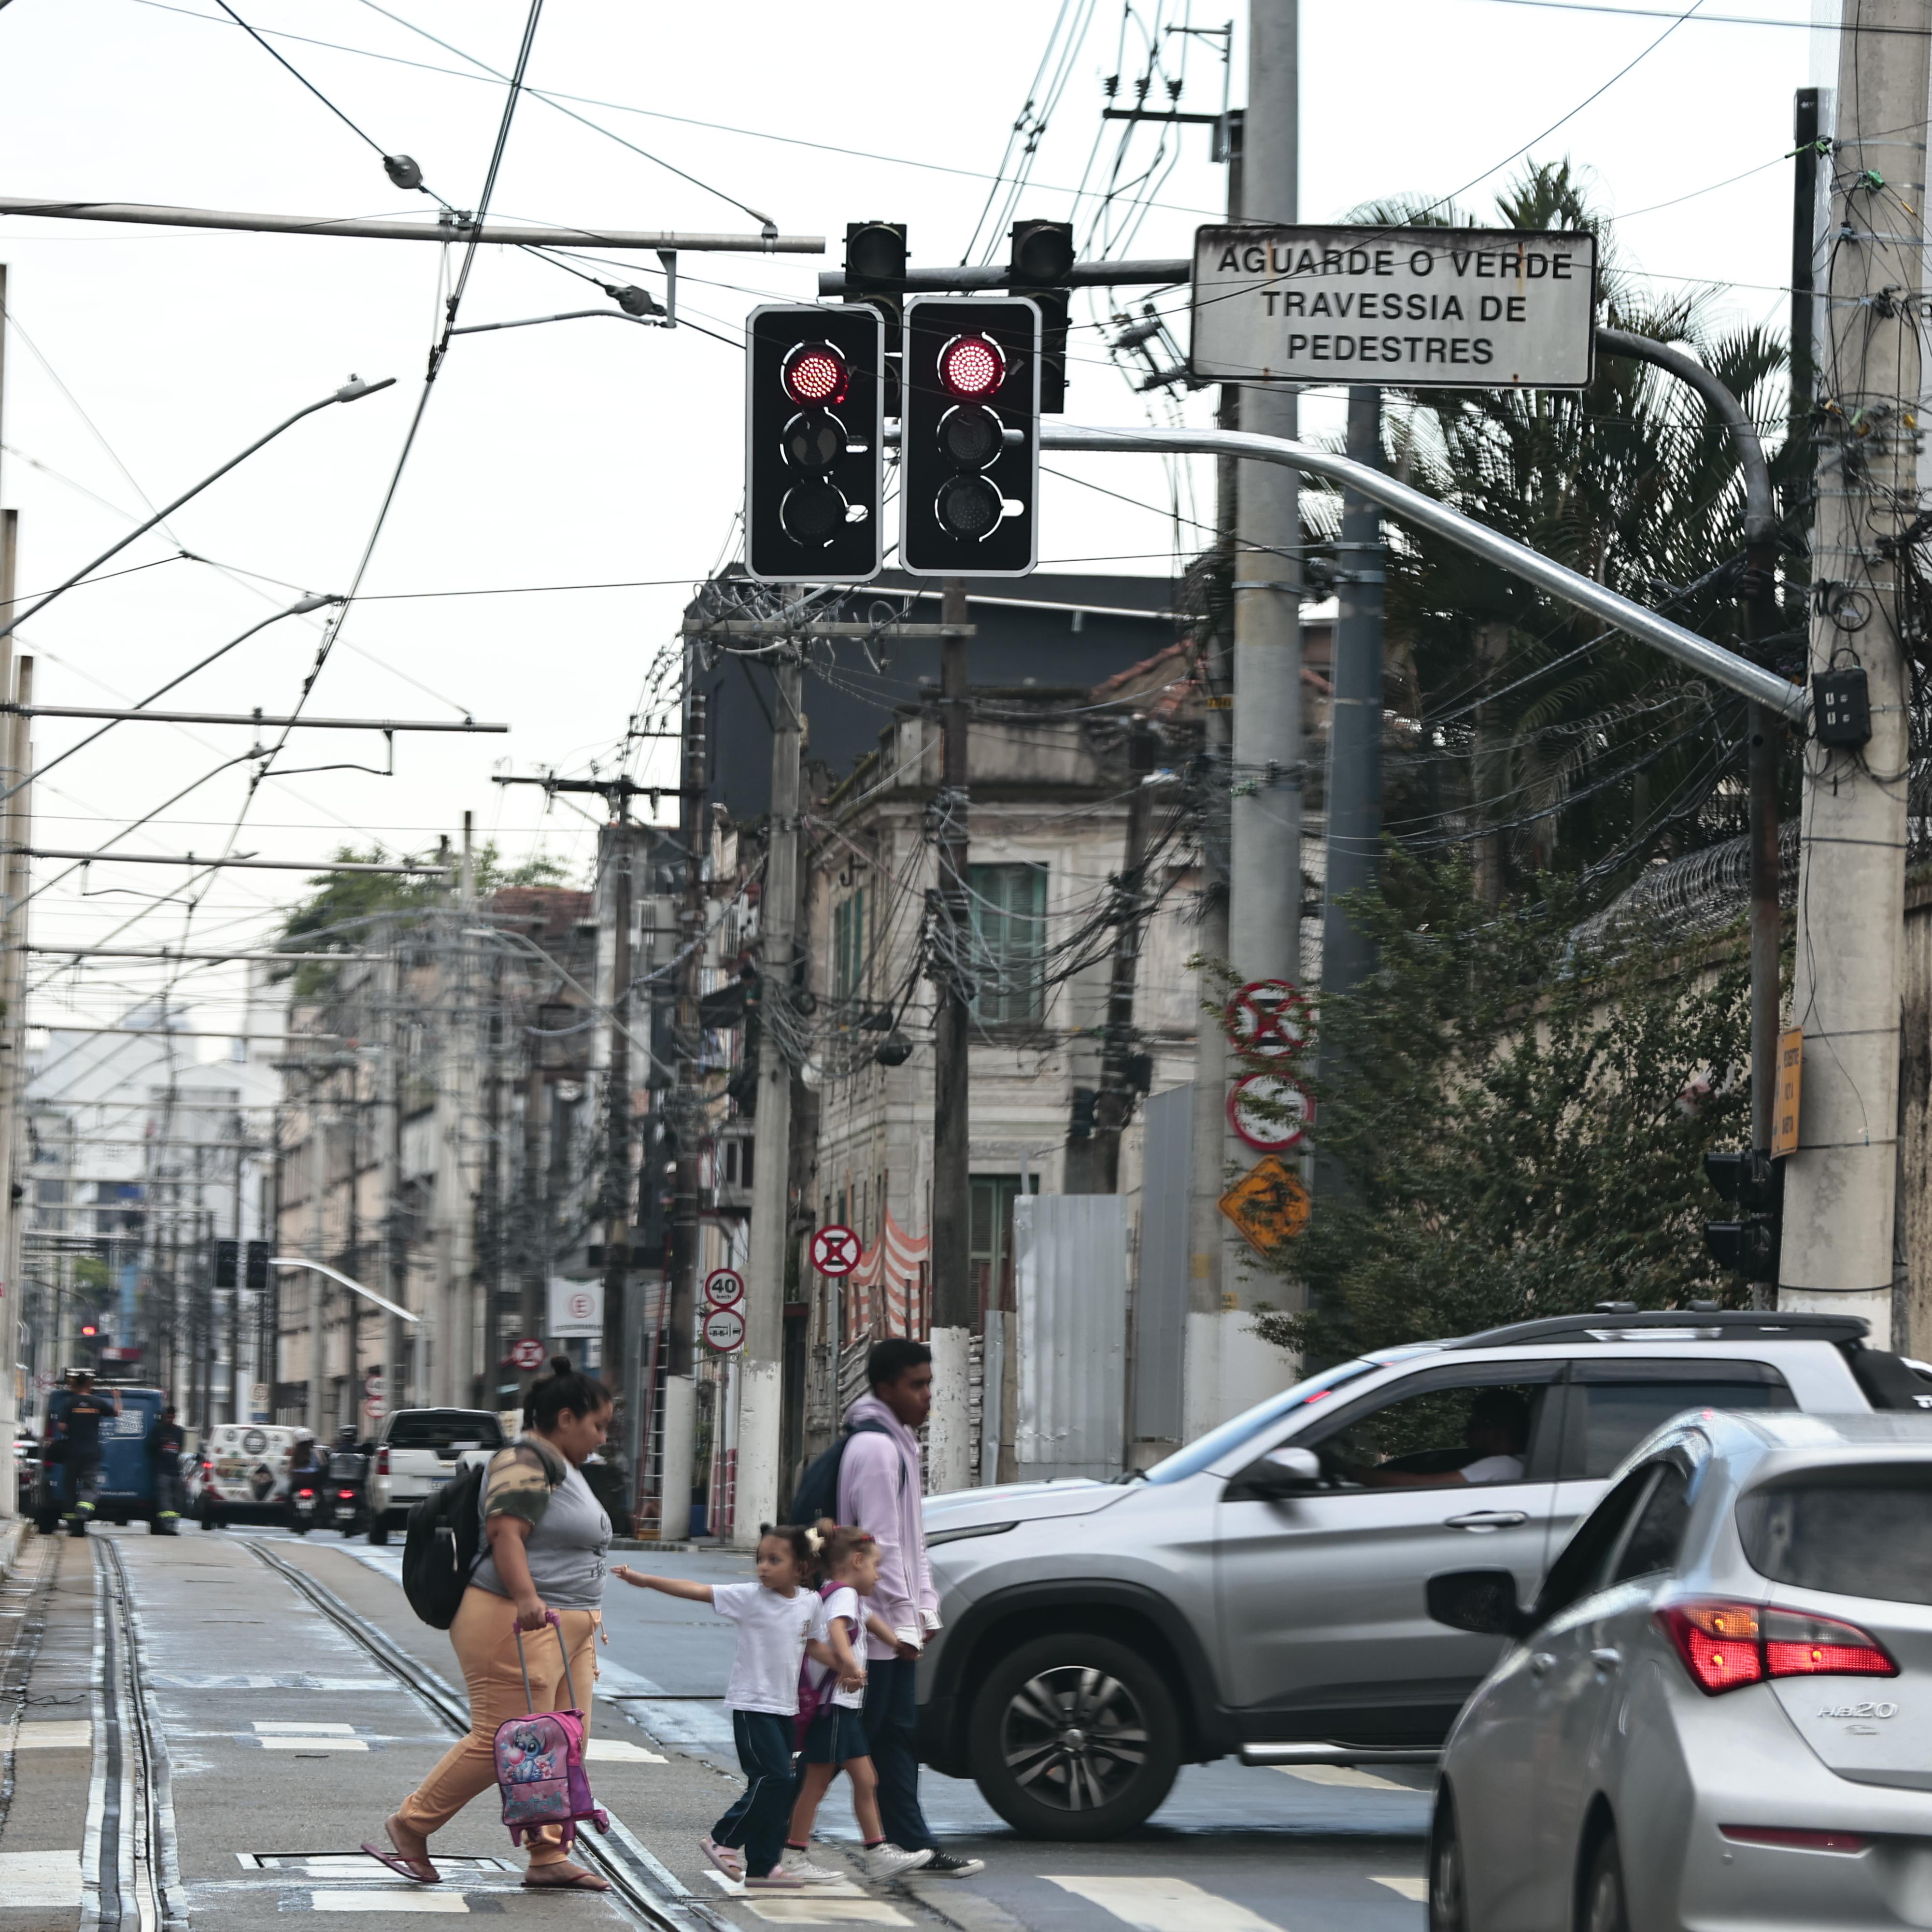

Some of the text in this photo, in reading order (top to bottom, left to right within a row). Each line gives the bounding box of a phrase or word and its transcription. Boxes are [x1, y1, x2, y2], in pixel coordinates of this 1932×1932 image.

[1217, 247, 1573, 279] AGUARDE O VERDE
[1261, 291, 1526, 322] TRAVESSIA DE
[1287, 334, 1493, 365] PEDESTRES
[712, 1279, 736, 1293] 40
[1816, 1701, 1899, 1719] HB20
